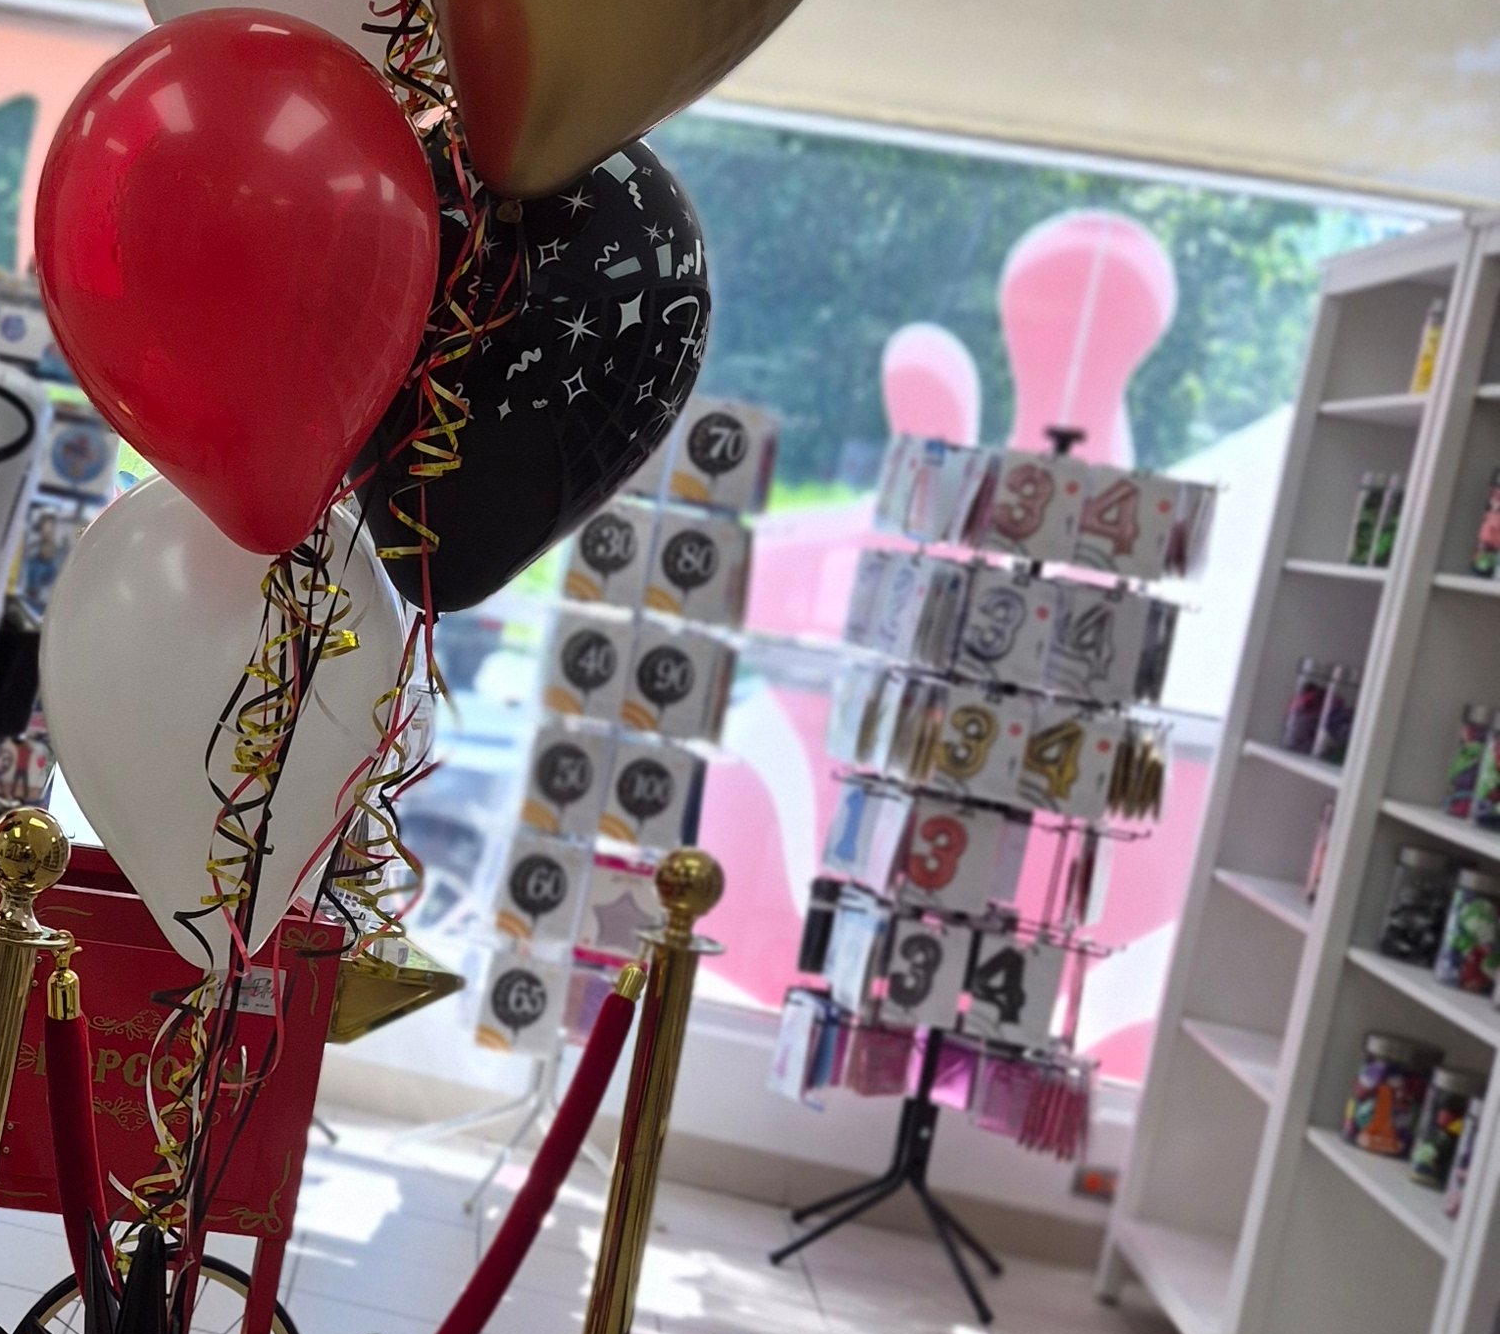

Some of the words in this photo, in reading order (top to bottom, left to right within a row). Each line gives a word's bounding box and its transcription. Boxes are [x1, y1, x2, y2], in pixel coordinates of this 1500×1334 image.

[709, 427, 747, 462] 70
[596, 525, 634, 559] 30
[676, 542, 718, 575] 80
[527, 869, 563, 900] 60
[508, 982, 544, 1014] 65
